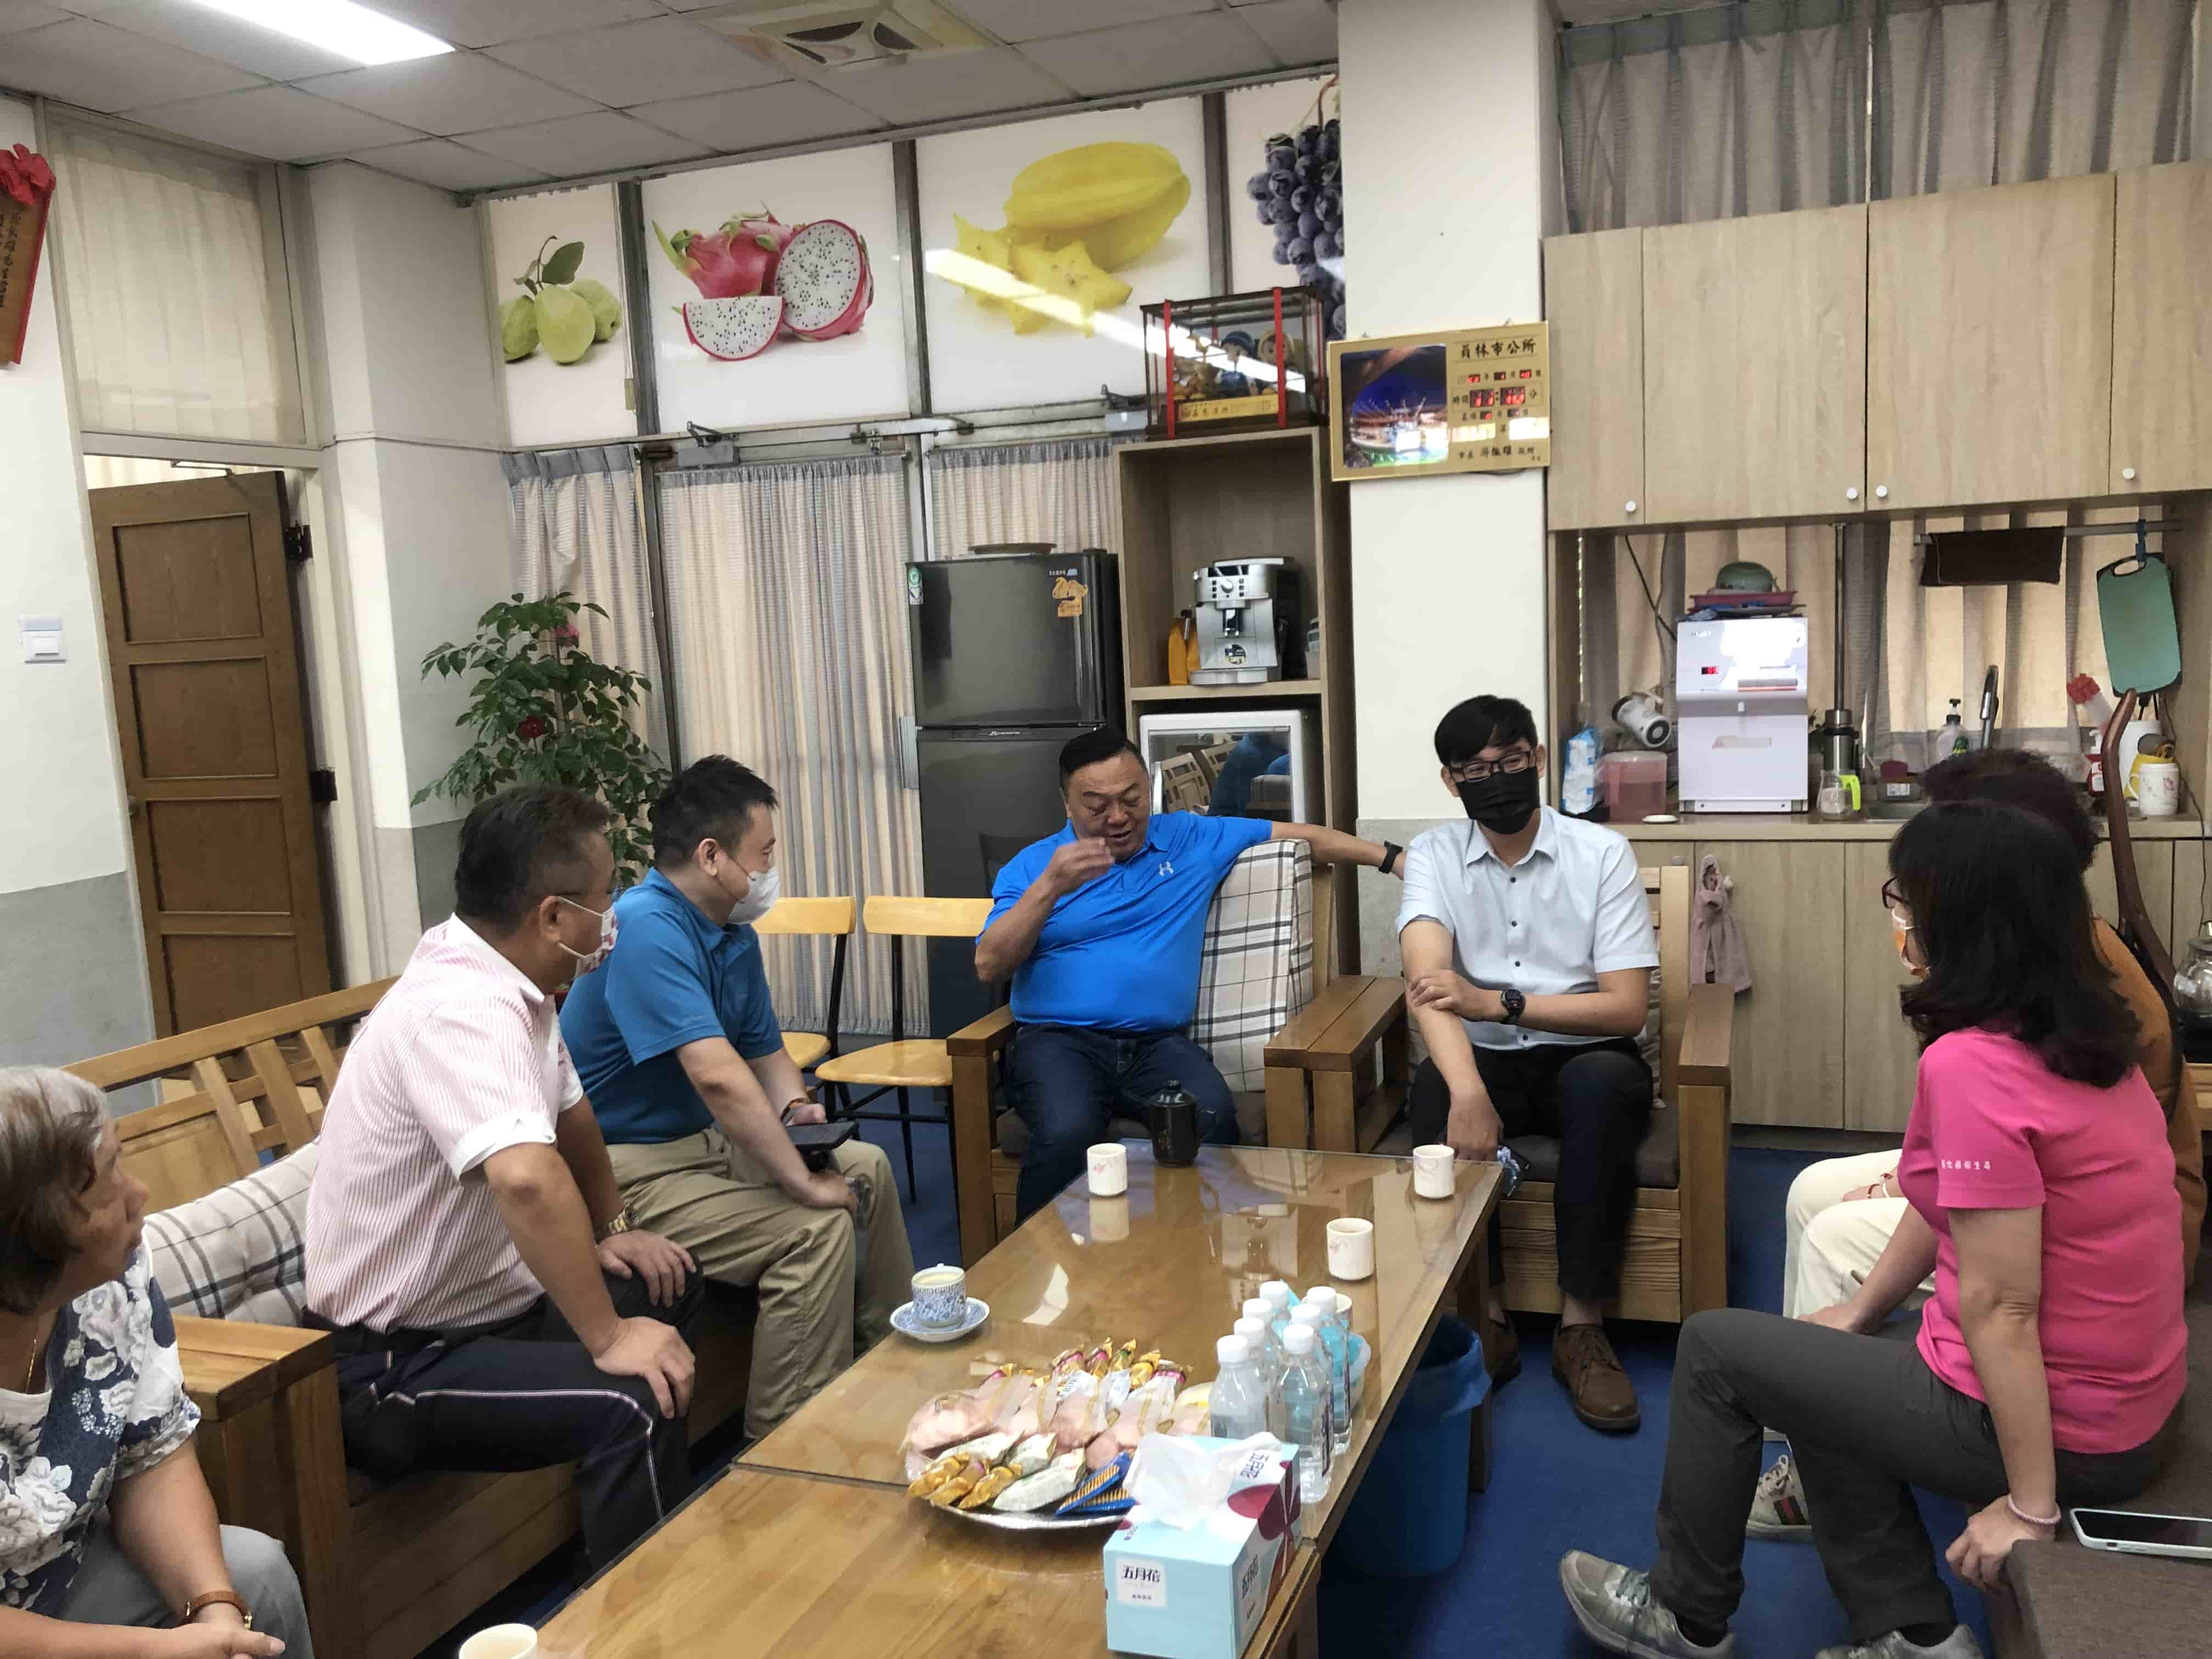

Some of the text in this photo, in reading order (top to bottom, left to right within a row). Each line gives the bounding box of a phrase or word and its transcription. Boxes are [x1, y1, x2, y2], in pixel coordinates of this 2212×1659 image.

[1462, 338, 1536, 358] 員林市公所
[1122, 1565, 1161, 1583] 五月花
